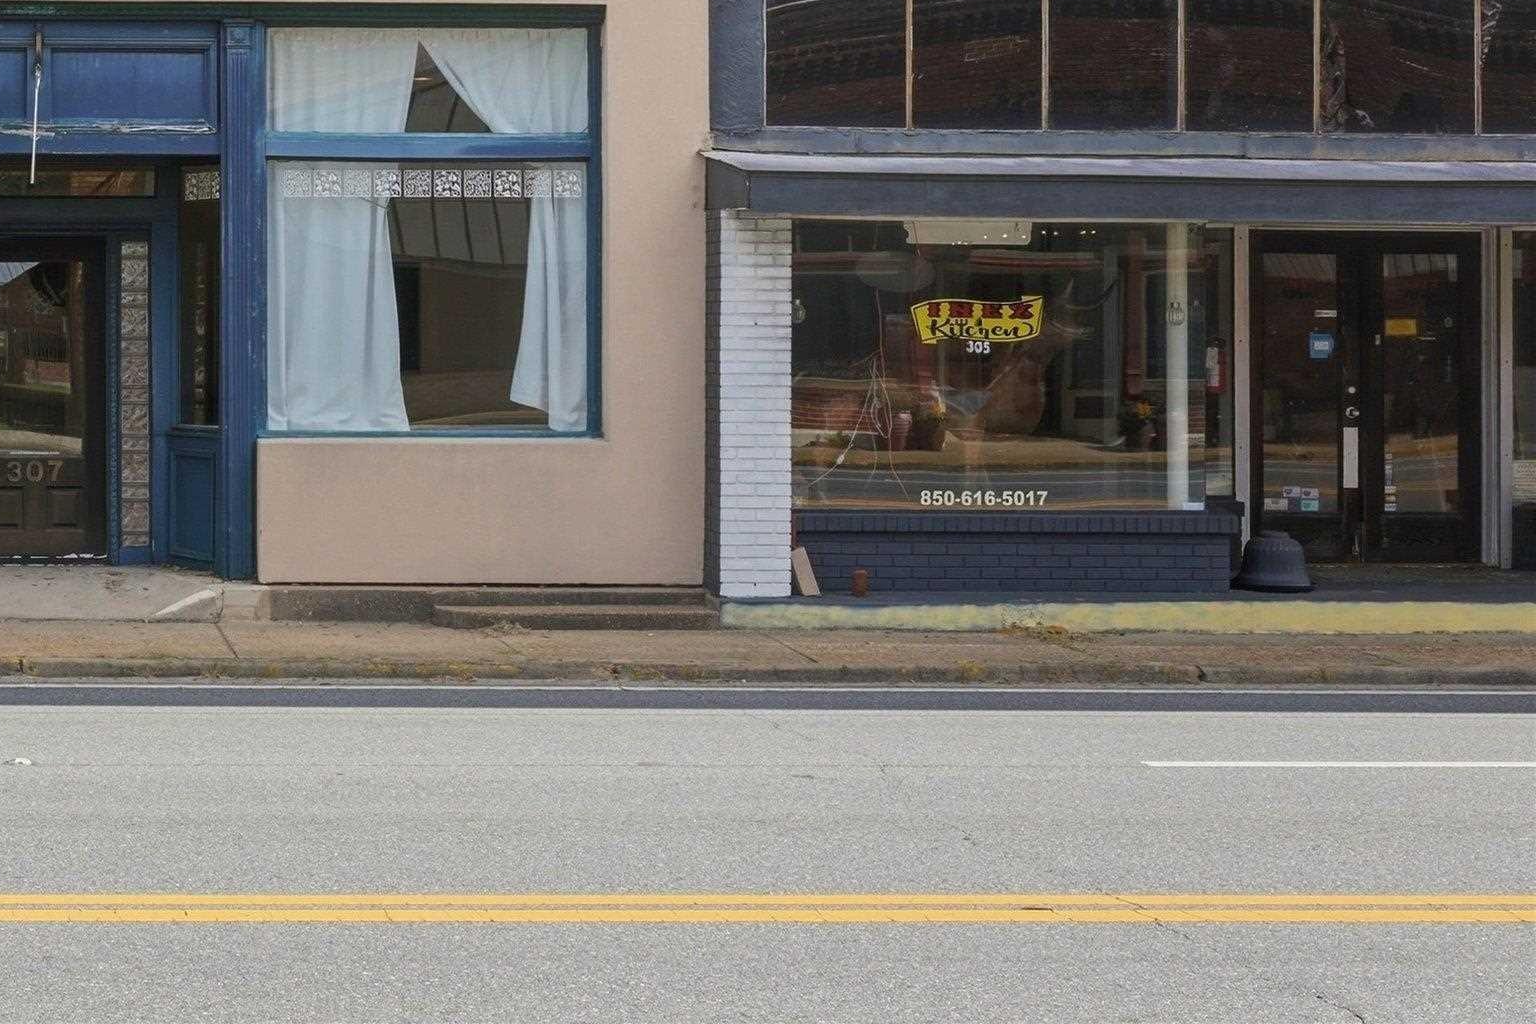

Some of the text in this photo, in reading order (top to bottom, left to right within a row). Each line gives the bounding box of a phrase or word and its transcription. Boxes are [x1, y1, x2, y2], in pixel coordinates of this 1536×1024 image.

[927, 318, 1035, 339] Kitchen
[965, 340, 991, 354] 305
[7, 461, 64, 482] 307
[920, 490, 1048, 506] 850-616-5017
